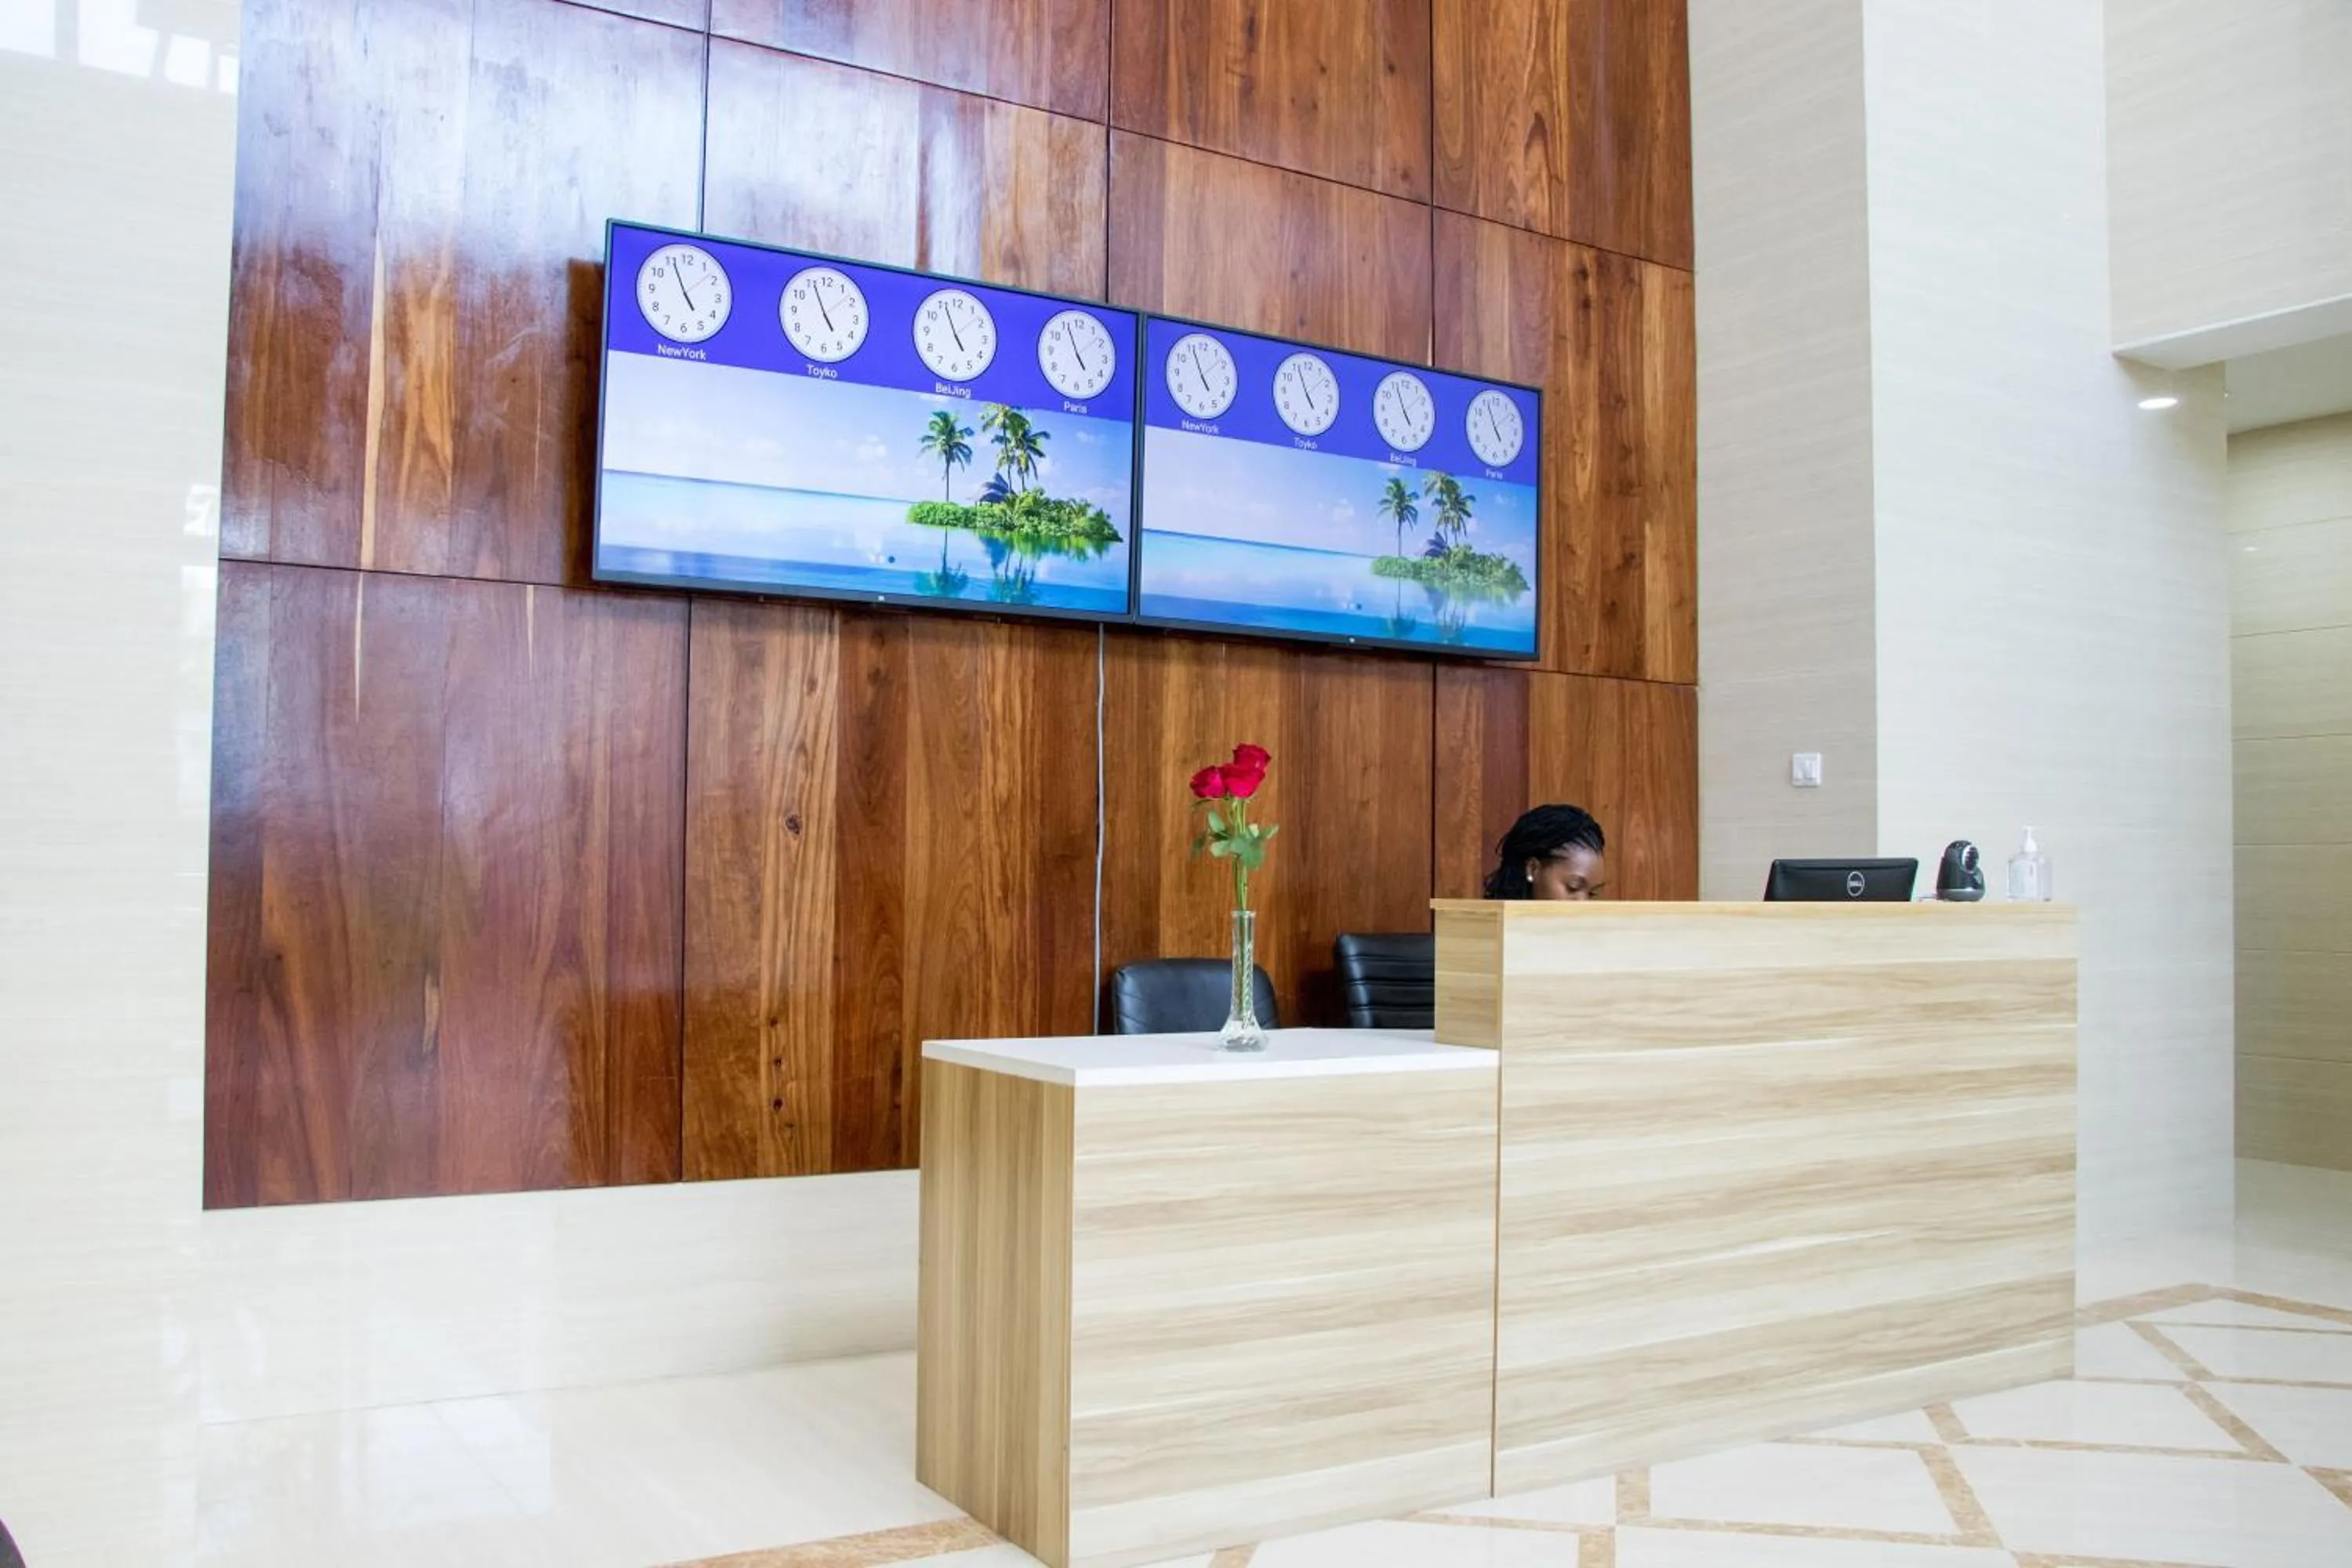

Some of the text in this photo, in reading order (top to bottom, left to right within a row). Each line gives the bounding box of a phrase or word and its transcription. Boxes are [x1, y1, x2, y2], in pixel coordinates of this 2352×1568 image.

[666, 256, 677, 266] 11
[681, 255, 694, 265] 12
[702, 262, 706, 271] 1
[652, 267, 664, 278] 10
[711, 276, 717, 285] 2
[822, 277, 833, 287] 12
[649, 284, 655, 293] 9
[840, 284, 844, 293] 1
[715, 294, 721, 303] 3
[793, 289, 805, 299] 10
[652, 302, 659, 311] 8
[849, 298, 855, 307] 2
[953, 299, 963, 308] 12
[710, 310, 716, 319] 4
[791, 306, 797, 314] 9
[971, 306, 975, 314] 1
[664, 315, 670, 325] 7
[853, 315, 858, 325] 3
[927, 310, 938, 321] 10
[681, 323, 687, 332] 6
[698, 321, 704, 330] 5
[794, 323, 800, 332] 8
[978, 319, 983, 328] 2
[848, 331, 854, 339] 4
[924, 327, 929, 336] 9
[805, 336, 811, 345] 7
[982, 336, 987, 345] 3
[821, 343, 826, 353] 6
[837, 342, 842, 350] 5
[927, 343, 932, 352] 8
[658, 343, 706, 360] NewYork
[978, 350, 982, 359] 4
[937, 356, 942, 365] 7
[967, 361, 972, 369] 5
[807, 364, 837, 379] Toyko
[952, 363, 956, 372] 6
